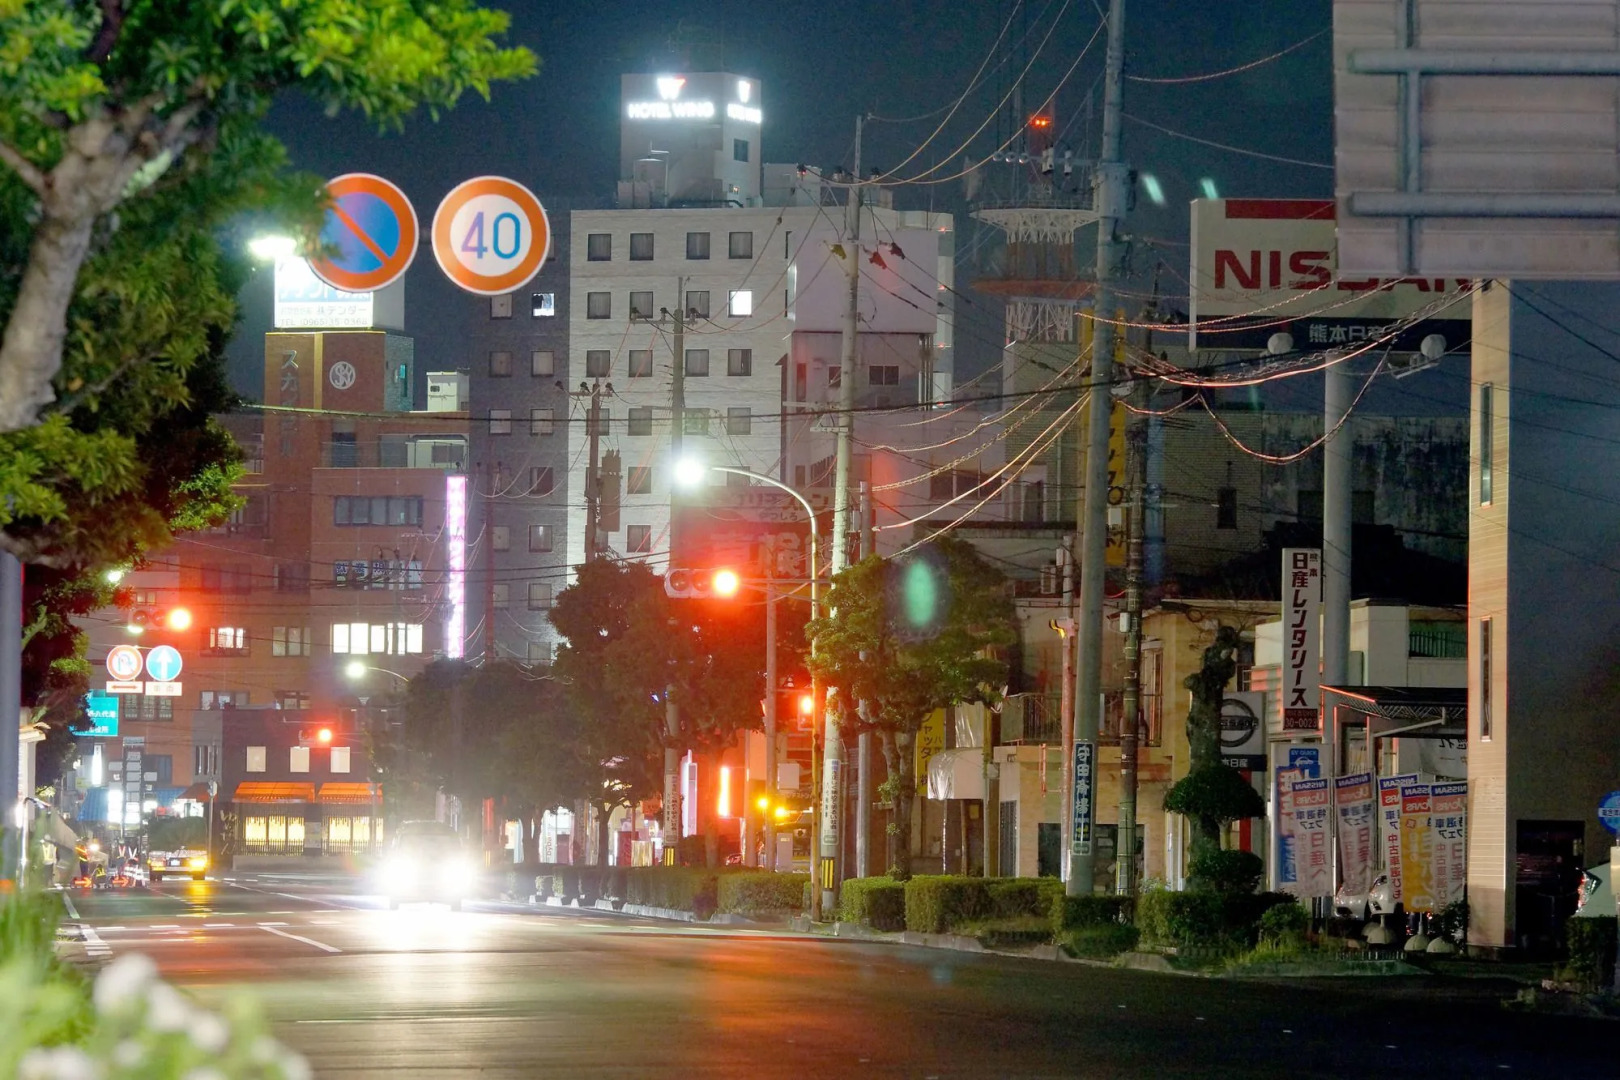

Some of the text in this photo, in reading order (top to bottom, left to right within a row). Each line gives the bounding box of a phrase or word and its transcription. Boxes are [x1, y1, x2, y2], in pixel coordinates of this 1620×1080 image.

[628, 102, 671, 118] HOTEL
[461, 211, 521, 259] 40
[1214, 250, 1473, 292] NIS
[281, 318, 296, 326] TEL
[1291, 552, 1308, 706] 日産レンタリース
